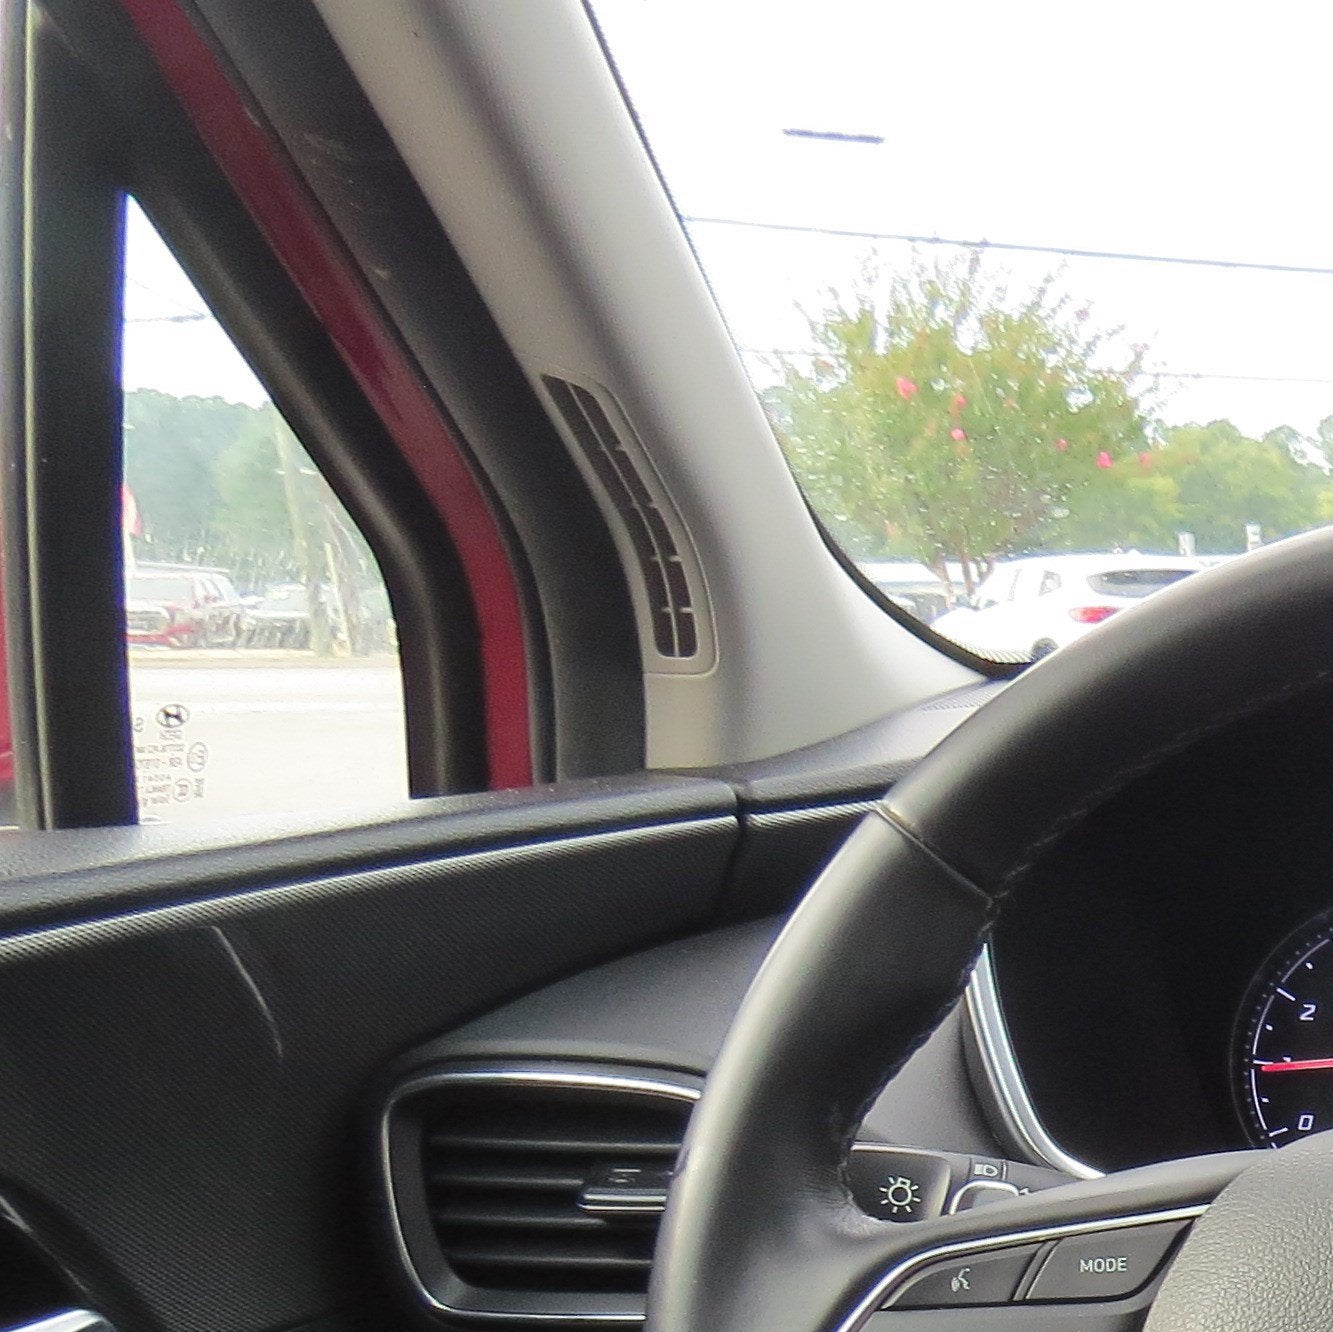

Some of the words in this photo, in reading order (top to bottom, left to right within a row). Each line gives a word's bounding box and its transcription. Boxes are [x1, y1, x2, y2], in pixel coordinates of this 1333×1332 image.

[1300, 1005, 1317, 1021] 2
[1298, 1114, 1314, 1131] 0
[1080, 1258, 1127, 1273] MODE
